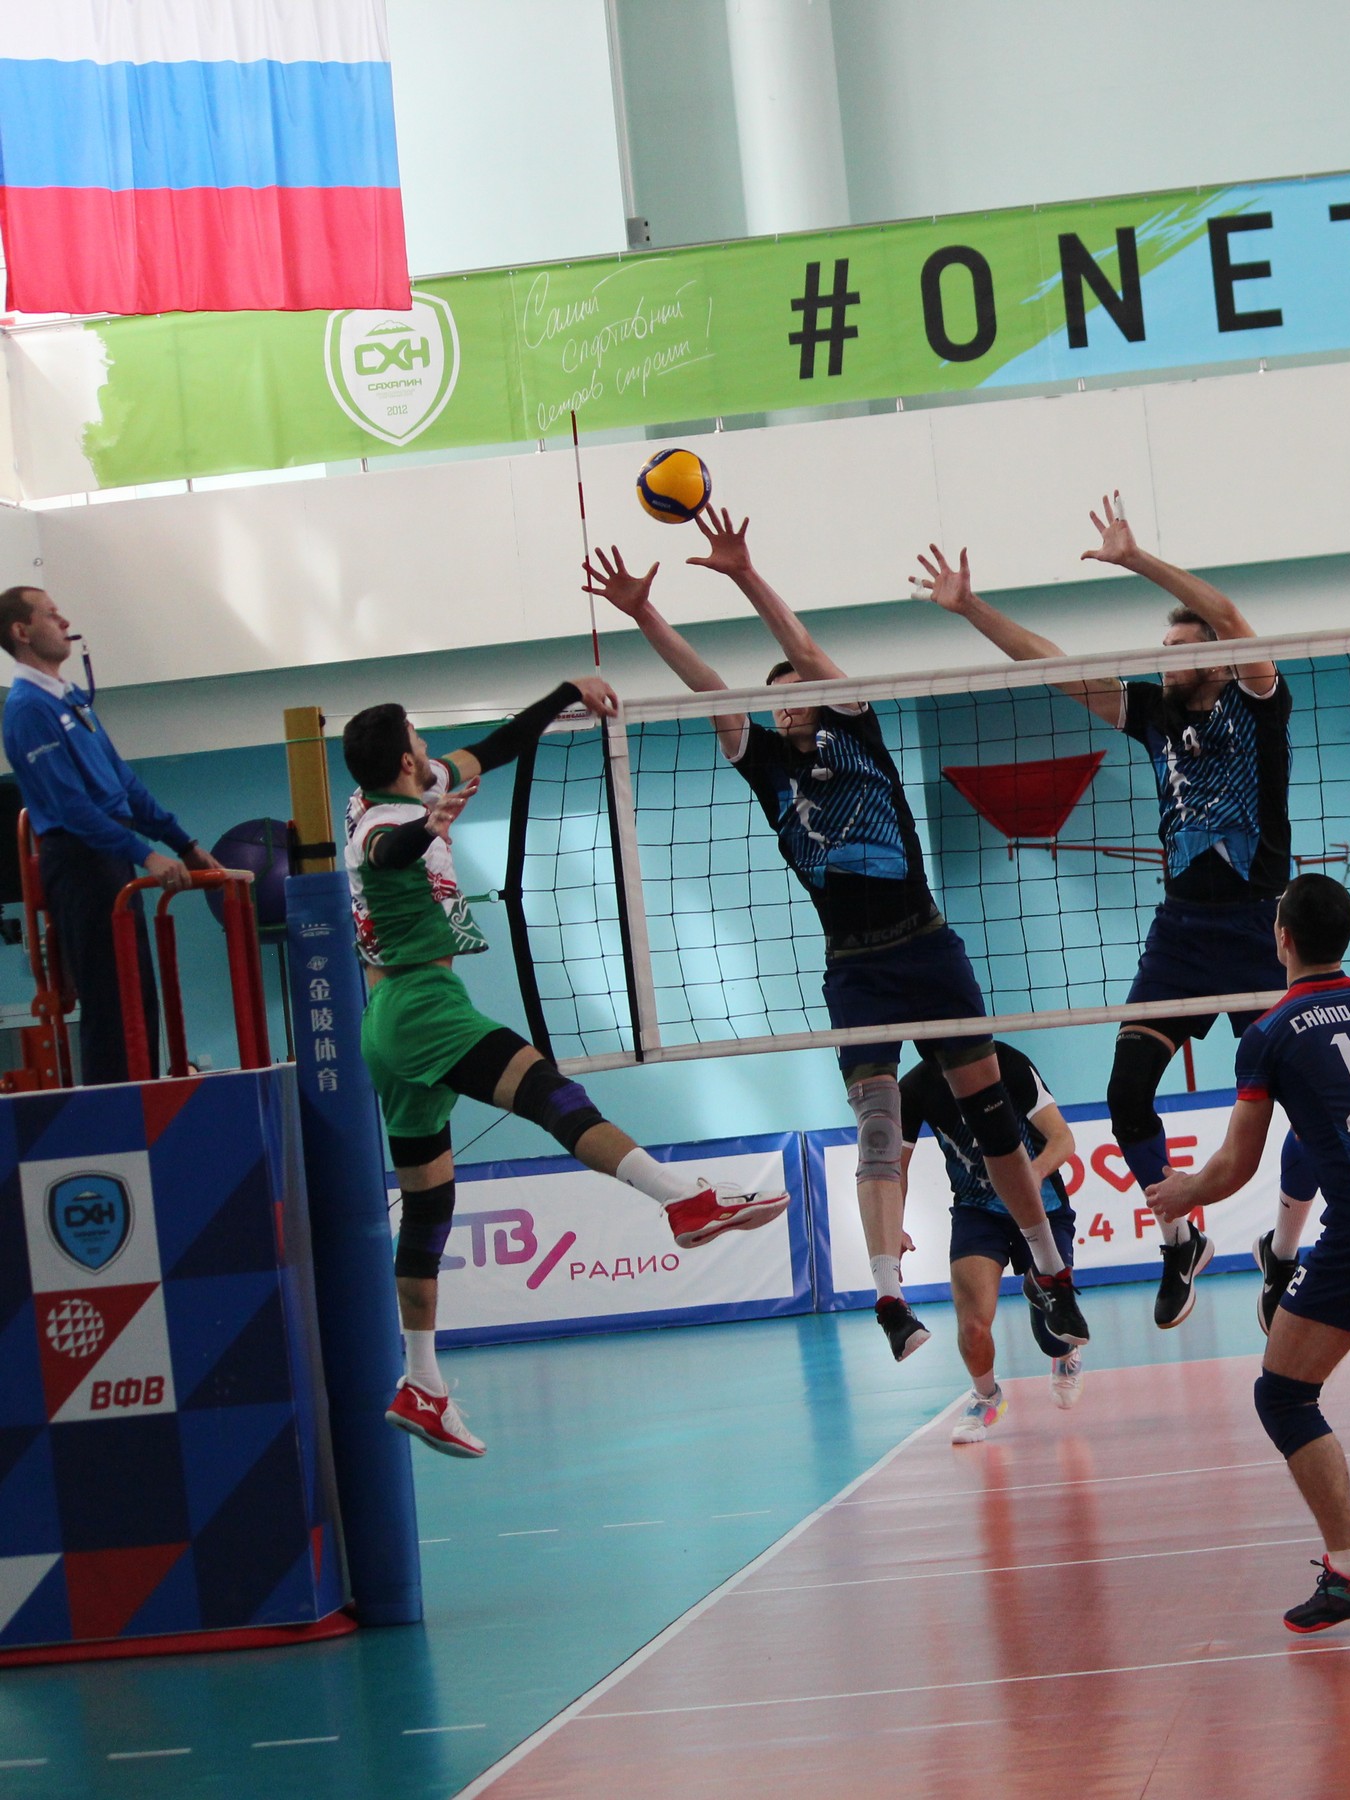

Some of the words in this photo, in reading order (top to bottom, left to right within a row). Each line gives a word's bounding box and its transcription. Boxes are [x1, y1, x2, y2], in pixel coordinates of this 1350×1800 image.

[367, 377, 423, 392] САХАЛИН
[386, 404, 409, 416] 2012
[308, 977, 339, 1092] 金陵体育
[569, 1253, 680, 1281] РАДИО
[89, 1375, 165, 1411] ВФВ
